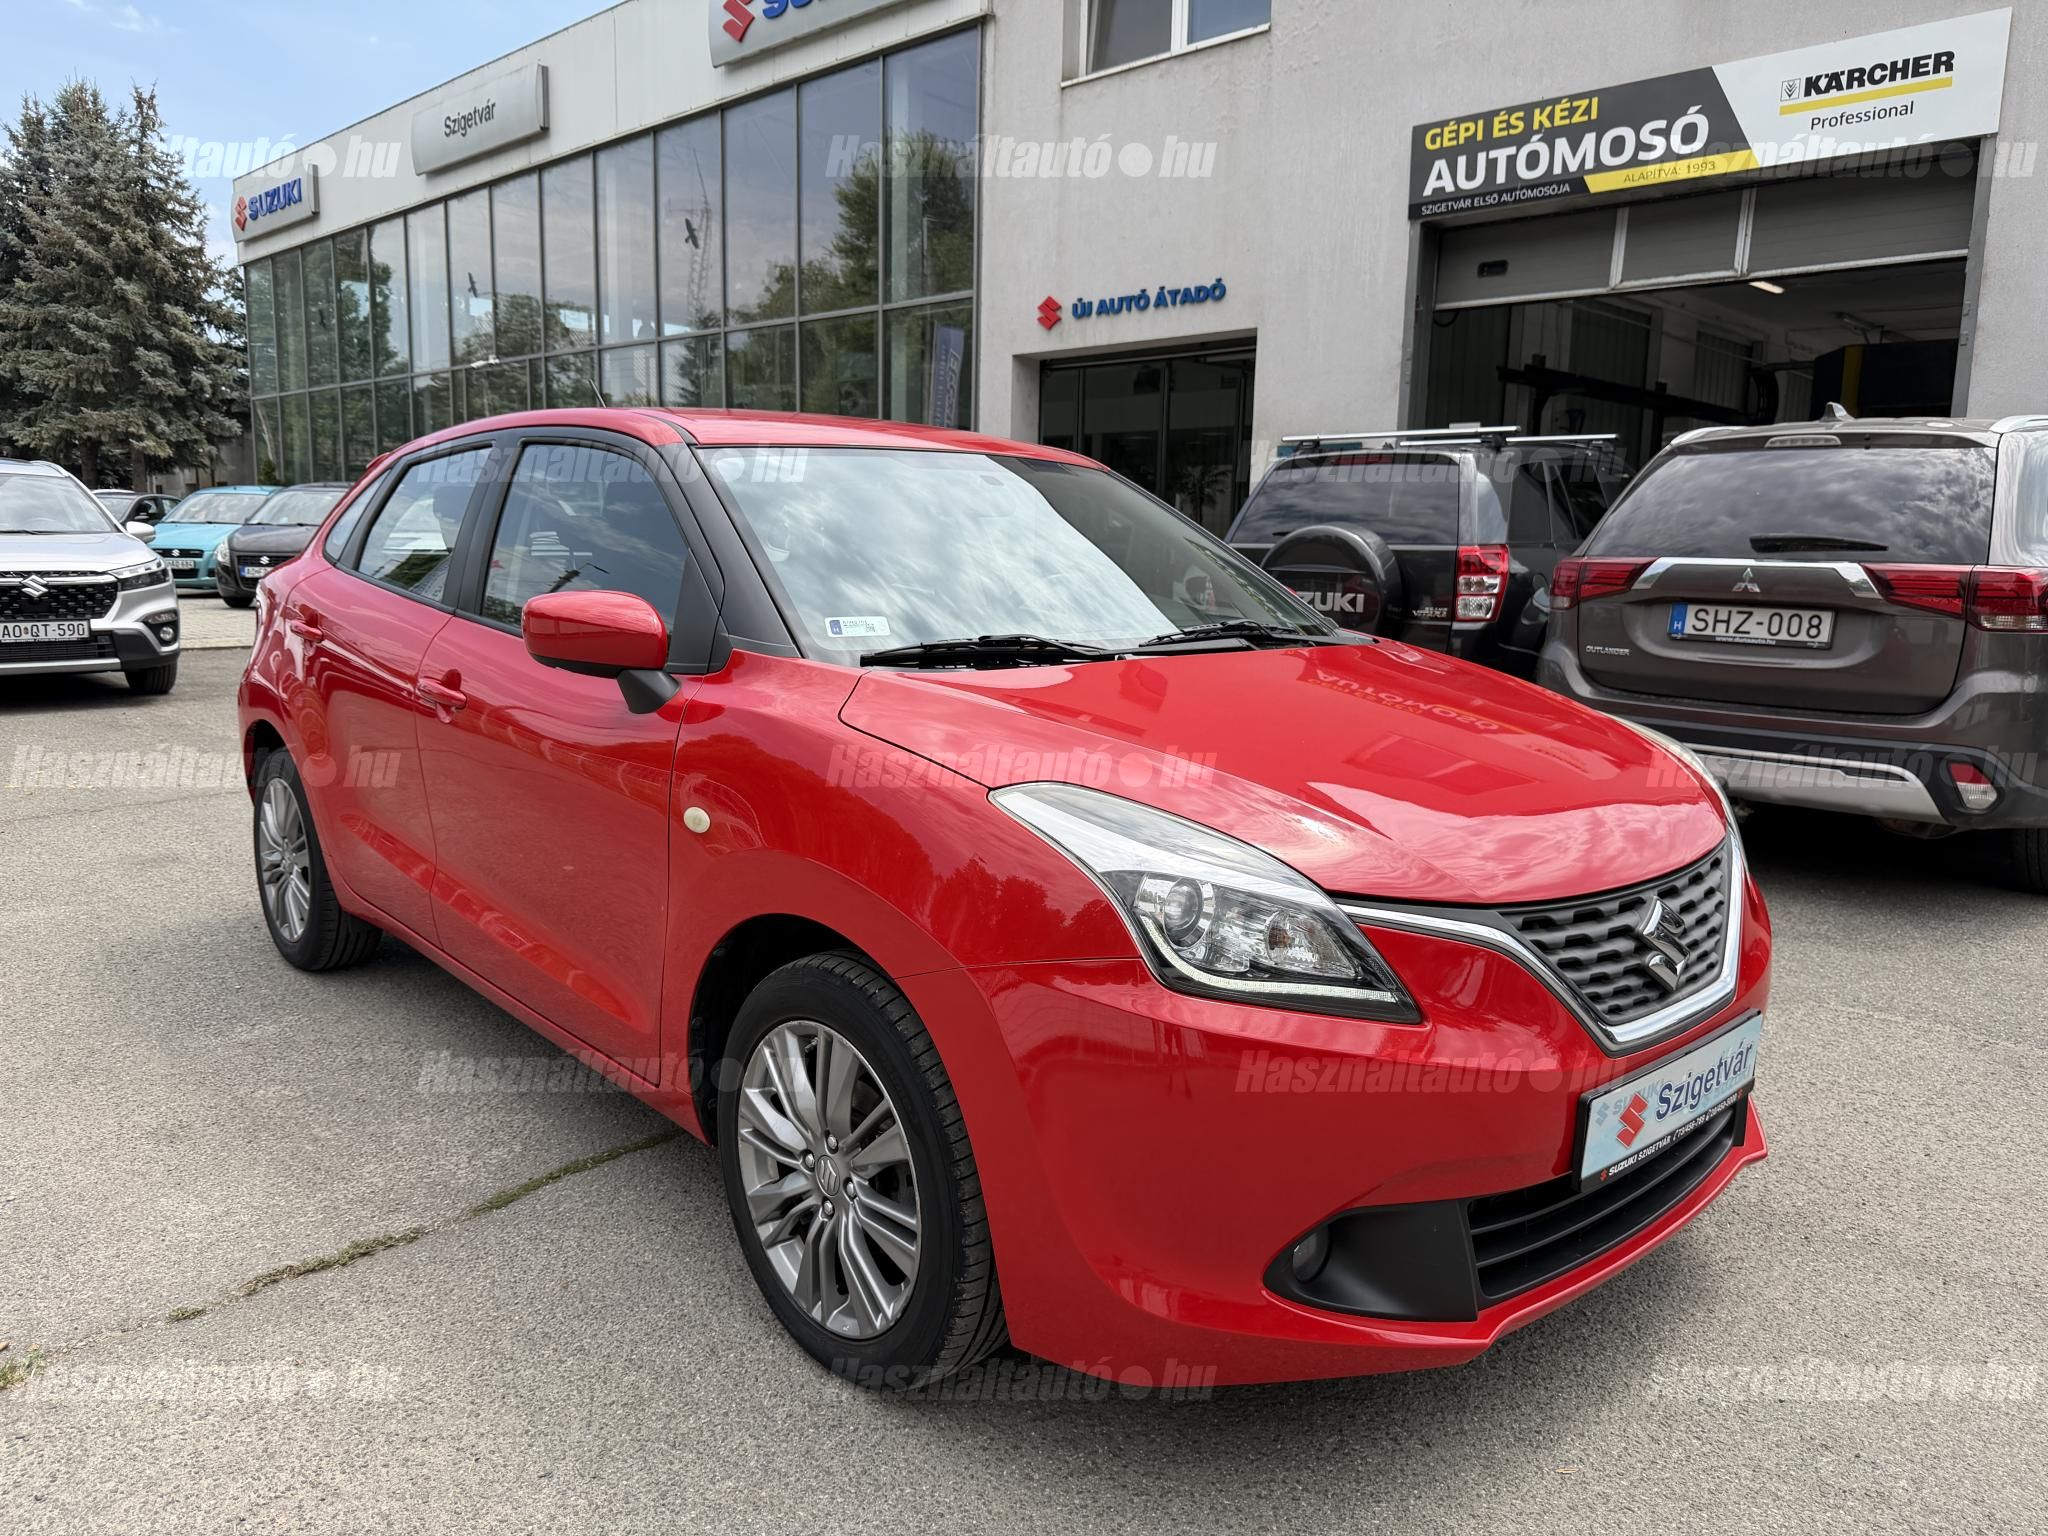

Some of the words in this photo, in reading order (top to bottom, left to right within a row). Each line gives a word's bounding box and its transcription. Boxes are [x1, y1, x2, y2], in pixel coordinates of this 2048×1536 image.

[1804, 51, 1955, 97] KÄRCHER
[443, 98, 497, 138] Szigetvár
[1424, 118, 1484, 151] GÉPI
[1492, 110, 1525, 139] ÉS
[1532, 96, 1599, 131] KÉZI
[1810, 100, 1914, 131] Professional
[1422, 104, 1709, 198] AUTÓMOSÓ
[1624, 167, 1681, 184] ALAPÍTVA:
[1686, 160, 1716, 174] 1993
[248, 177, 302, 221] SUZUKI
[1421, 198, 1472, 215] SZIGETVÁR
[1096, 288, 1150, 316] AUTÓ
[1153, 277, 1227, 308] ÁTADÓ
[1296, 591, 1365, 614] ZUKI
[1692, 608, 1823, 640] SHZ-008
[1656, 1041, 1753, 1120] Szigetvár
[1608, 1153, 1638, 1176] SUZUKI
[1637, 1134, 1672, 1161] SZIGETVÁR
